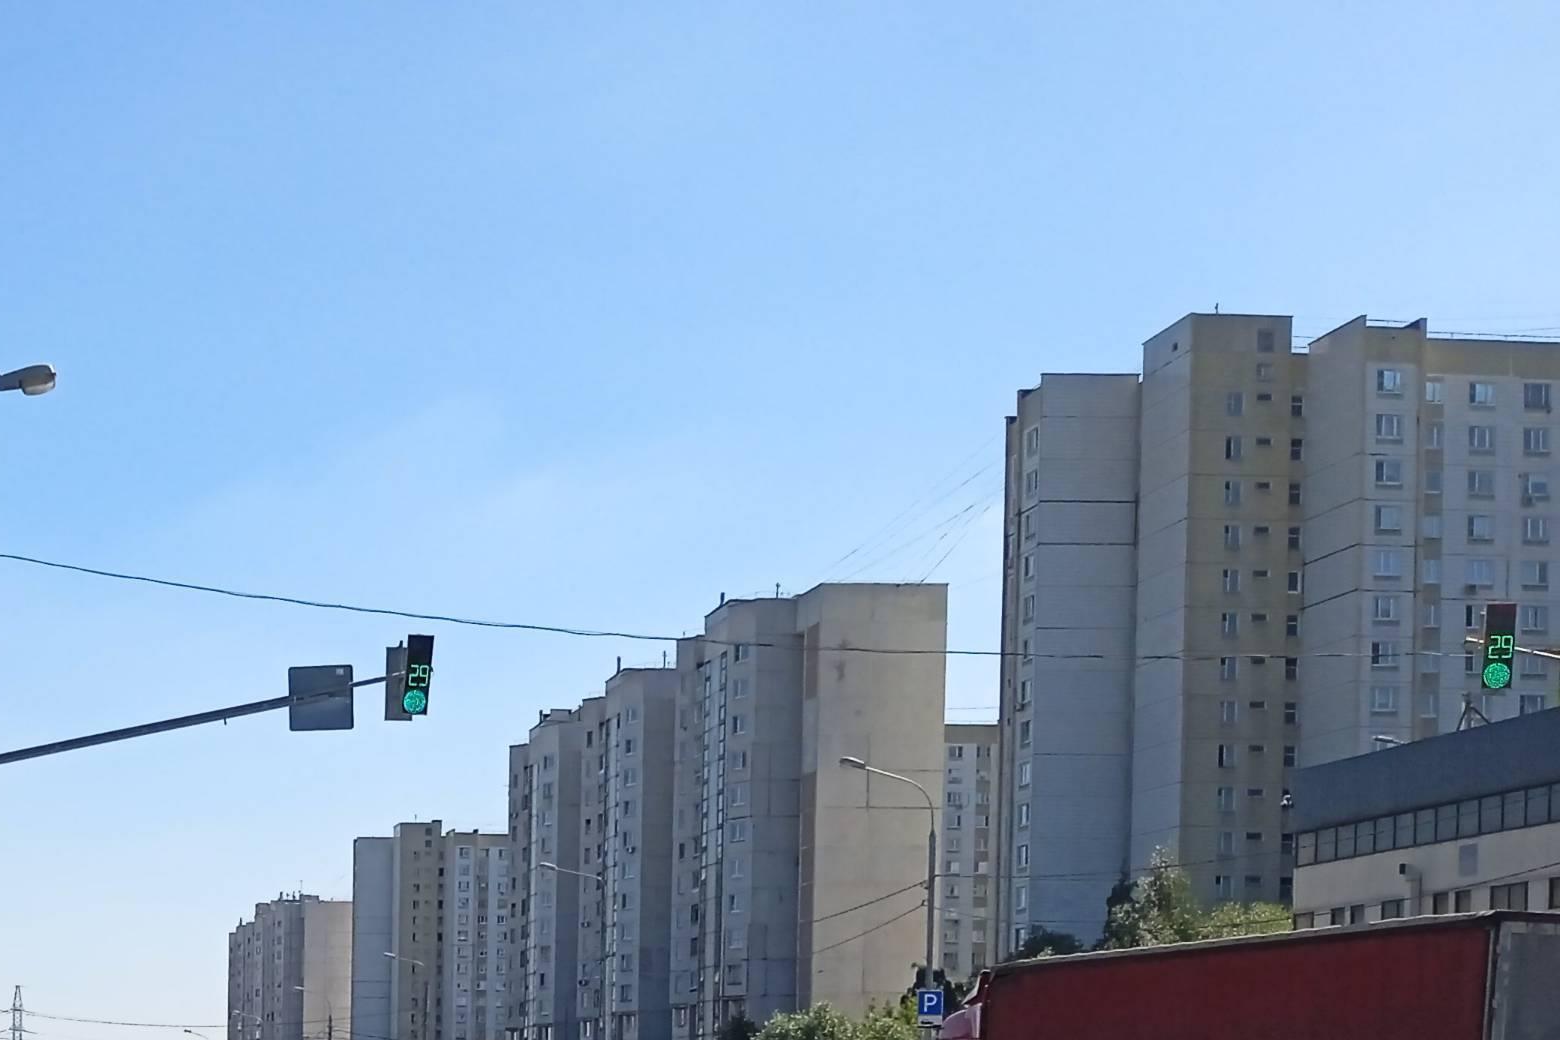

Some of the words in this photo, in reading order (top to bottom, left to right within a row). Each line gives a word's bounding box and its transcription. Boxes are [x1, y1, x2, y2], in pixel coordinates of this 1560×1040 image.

[1487, 635, 1514, 659] 29
[408, 664, 430, 687] 29
[923, 993, 938, 1013] P
